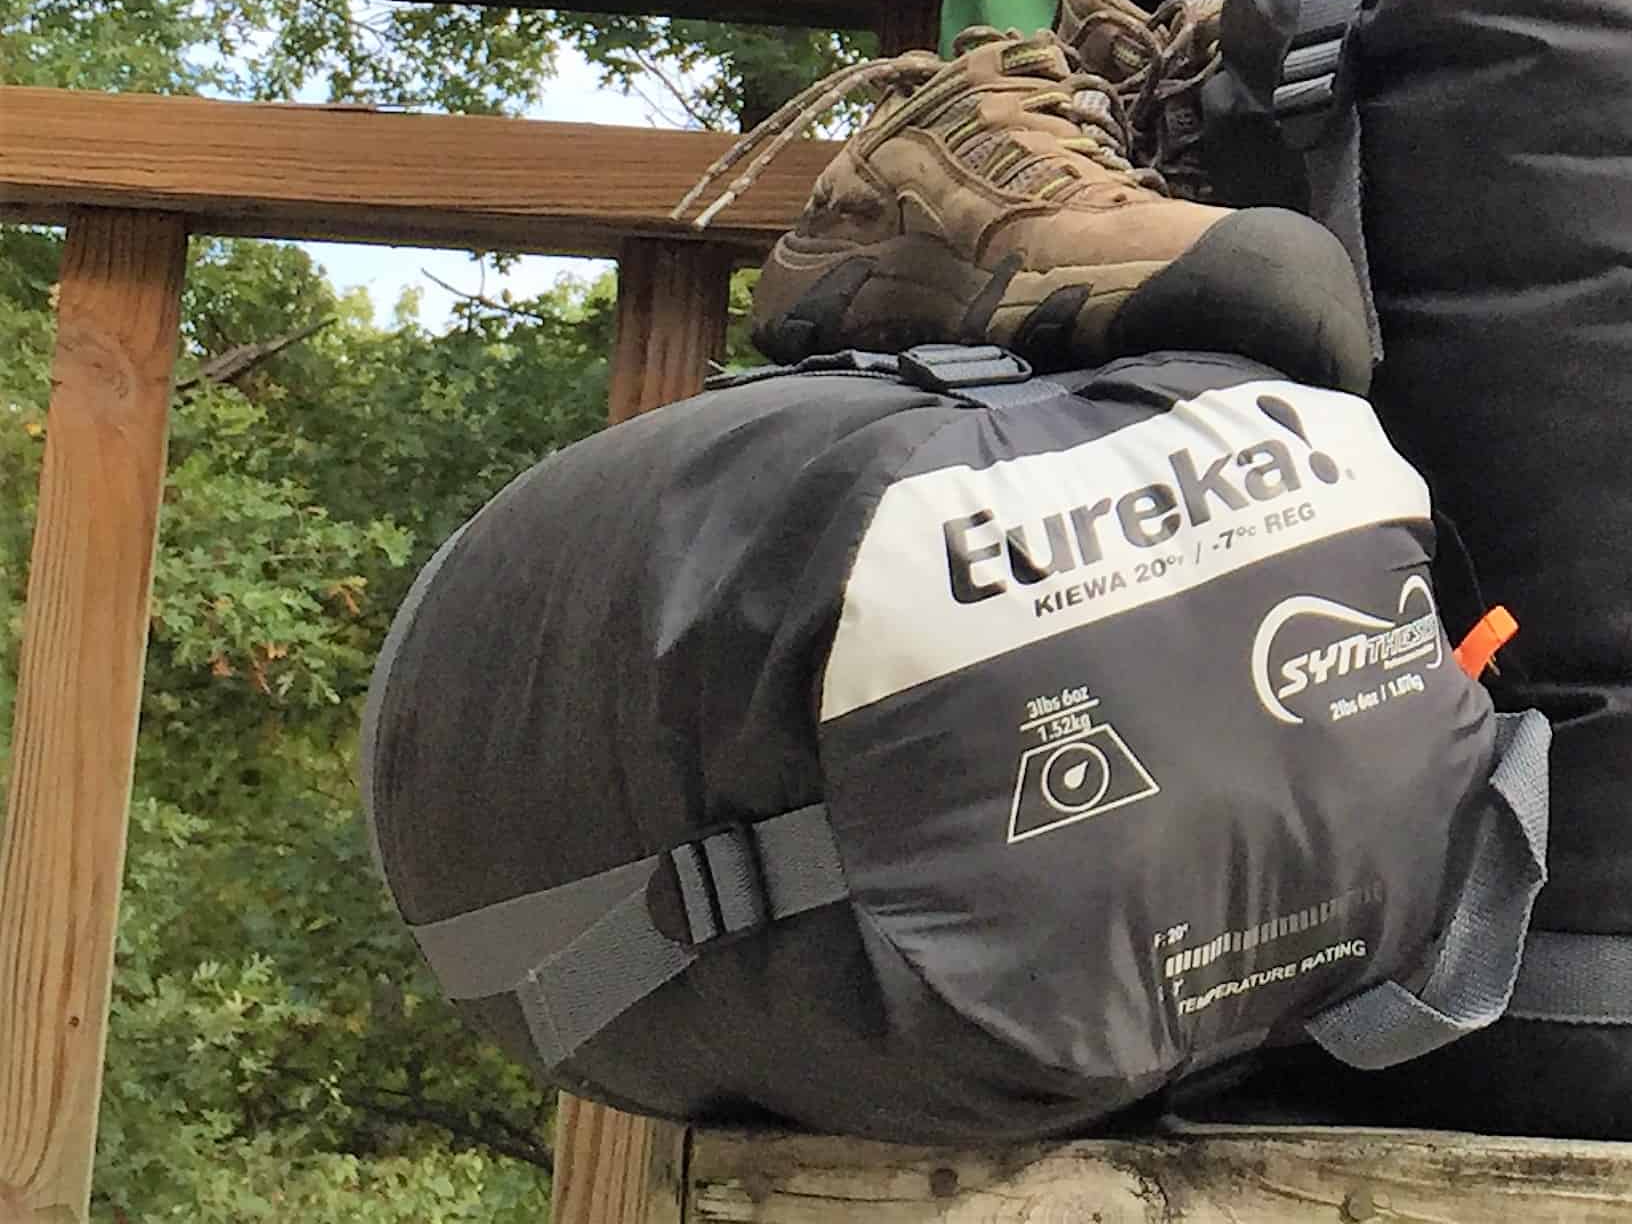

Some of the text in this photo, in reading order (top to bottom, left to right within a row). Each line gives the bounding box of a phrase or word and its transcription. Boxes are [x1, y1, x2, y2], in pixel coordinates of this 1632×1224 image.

[943, 394, 1340, 604] Eureka!
[1034, 571, 1127, 617] KIEWA
[1263, 502, 1316, 535] REG
[1027, 686, 1090, 719] 3lbs 6oz
[1037, 713, 1092, 742] 1.52kg
[1301, 940, 1367, 974] RATING
